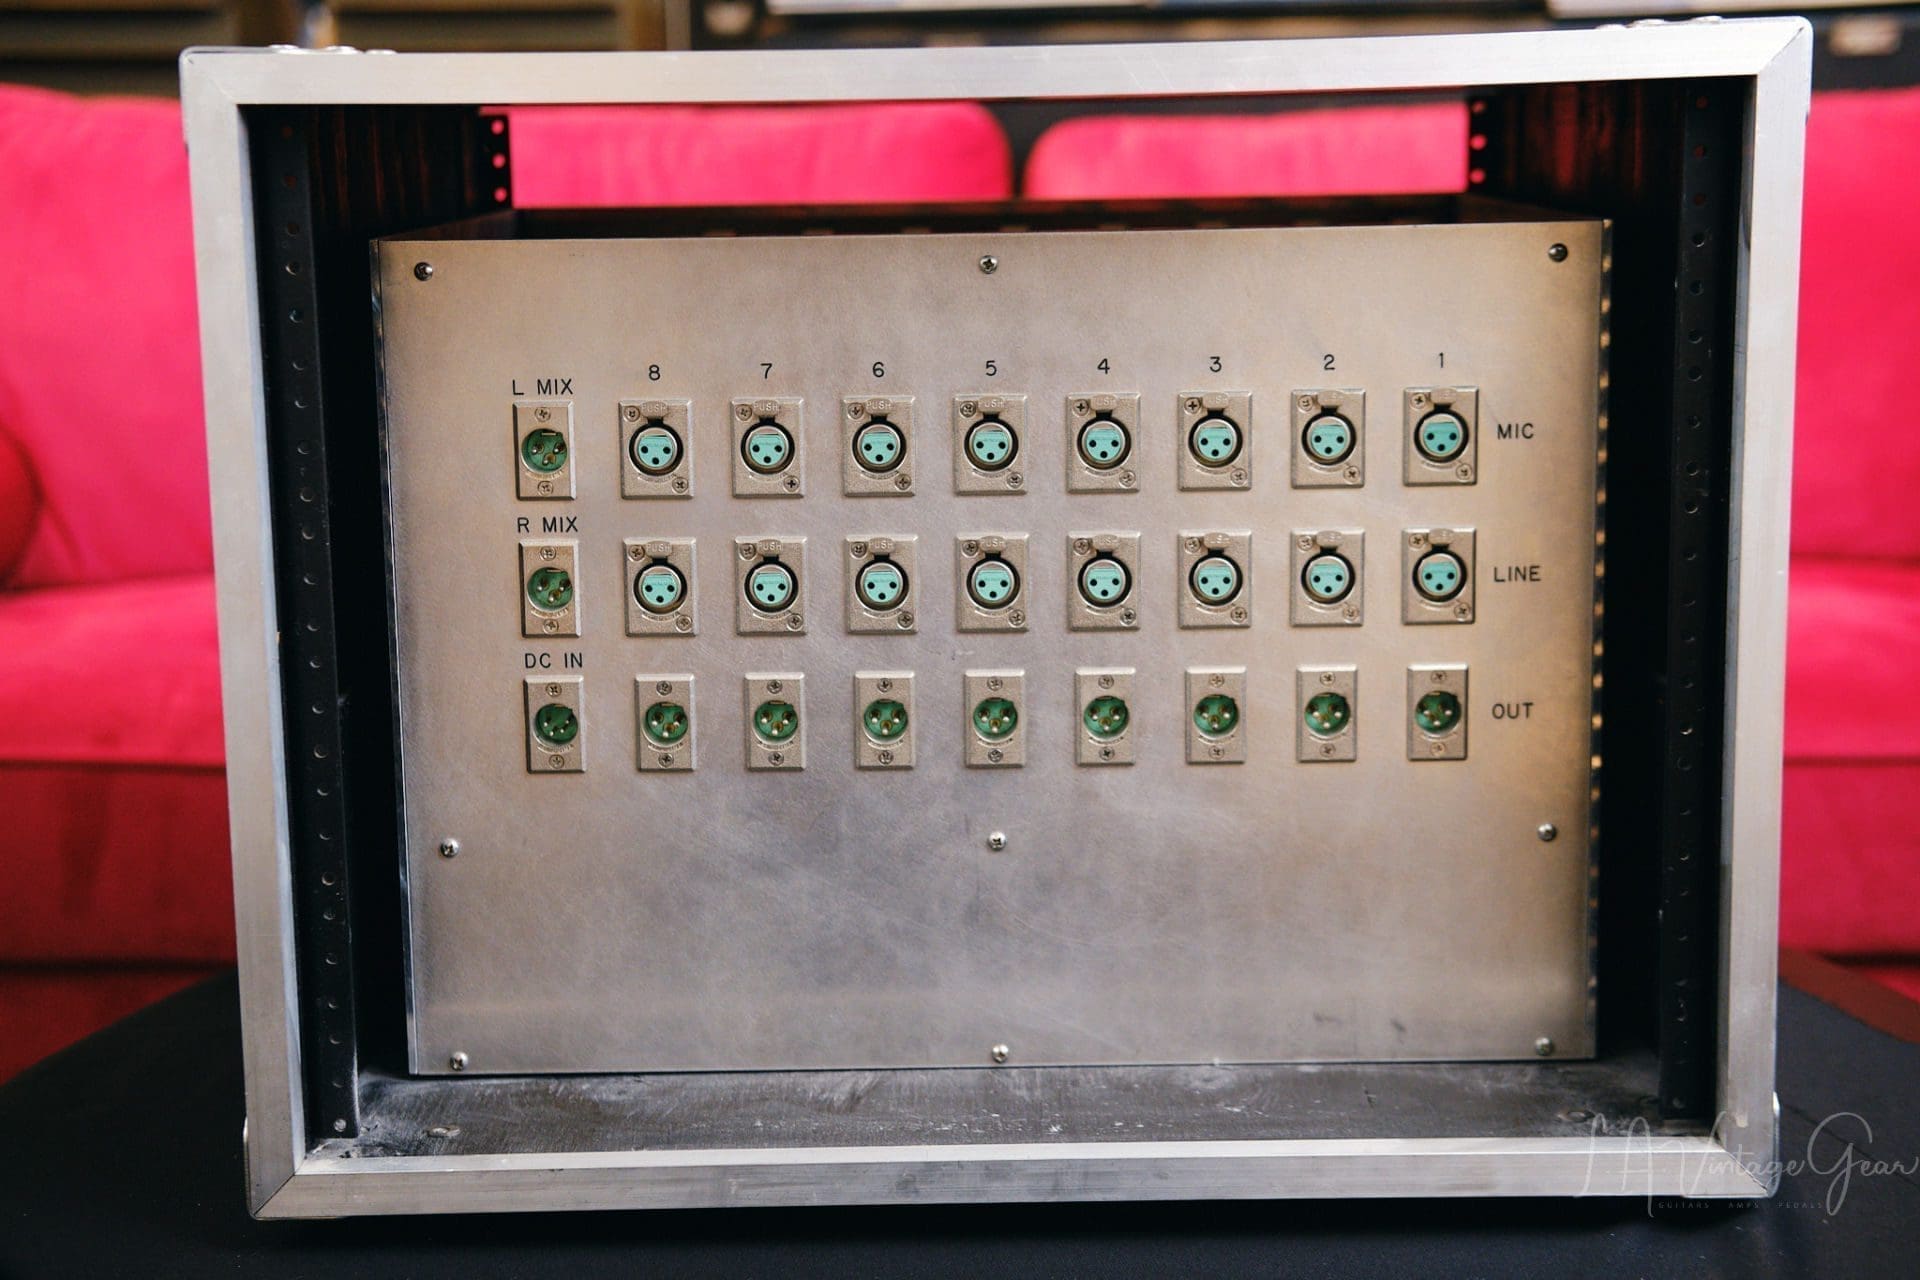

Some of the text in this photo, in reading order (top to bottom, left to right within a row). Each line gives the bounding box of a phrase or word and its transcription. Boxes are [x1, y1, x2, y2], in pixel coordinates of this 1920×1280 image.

[985, 359, 998, 377] 5
[1096, 357, 1111, 375] 4
[1209, 355, 1223, 374] 3
[1323, 353, 1336, 371] 2
[1438, 351, 1446, 369] 1
[648, 363, 661, 382] 8
[759, 362, 773, 380] 7
[871, 361, 885, 379] 6
[511, 377, 574, 396] L MIX
[642, 404, 667, 414] PUSH
[753, 402, 778, 412] PUSH
[866, 400, 892, 410] PUSH
[1497, 422, 1535, 440] MIC
[516, 515, 579, 534] R MIX
[647, 543, 671, 552] PUSH
[757, 541, 782, 551] PUSH
[869, 540, 894, 549] PUSH
[980, 538, 1005, 548] PUSH
[1493, 564, 1542, 583] LINE
[524, 651, 583, 670] DC IN
[1491, 701, 1535, 720] OUT
